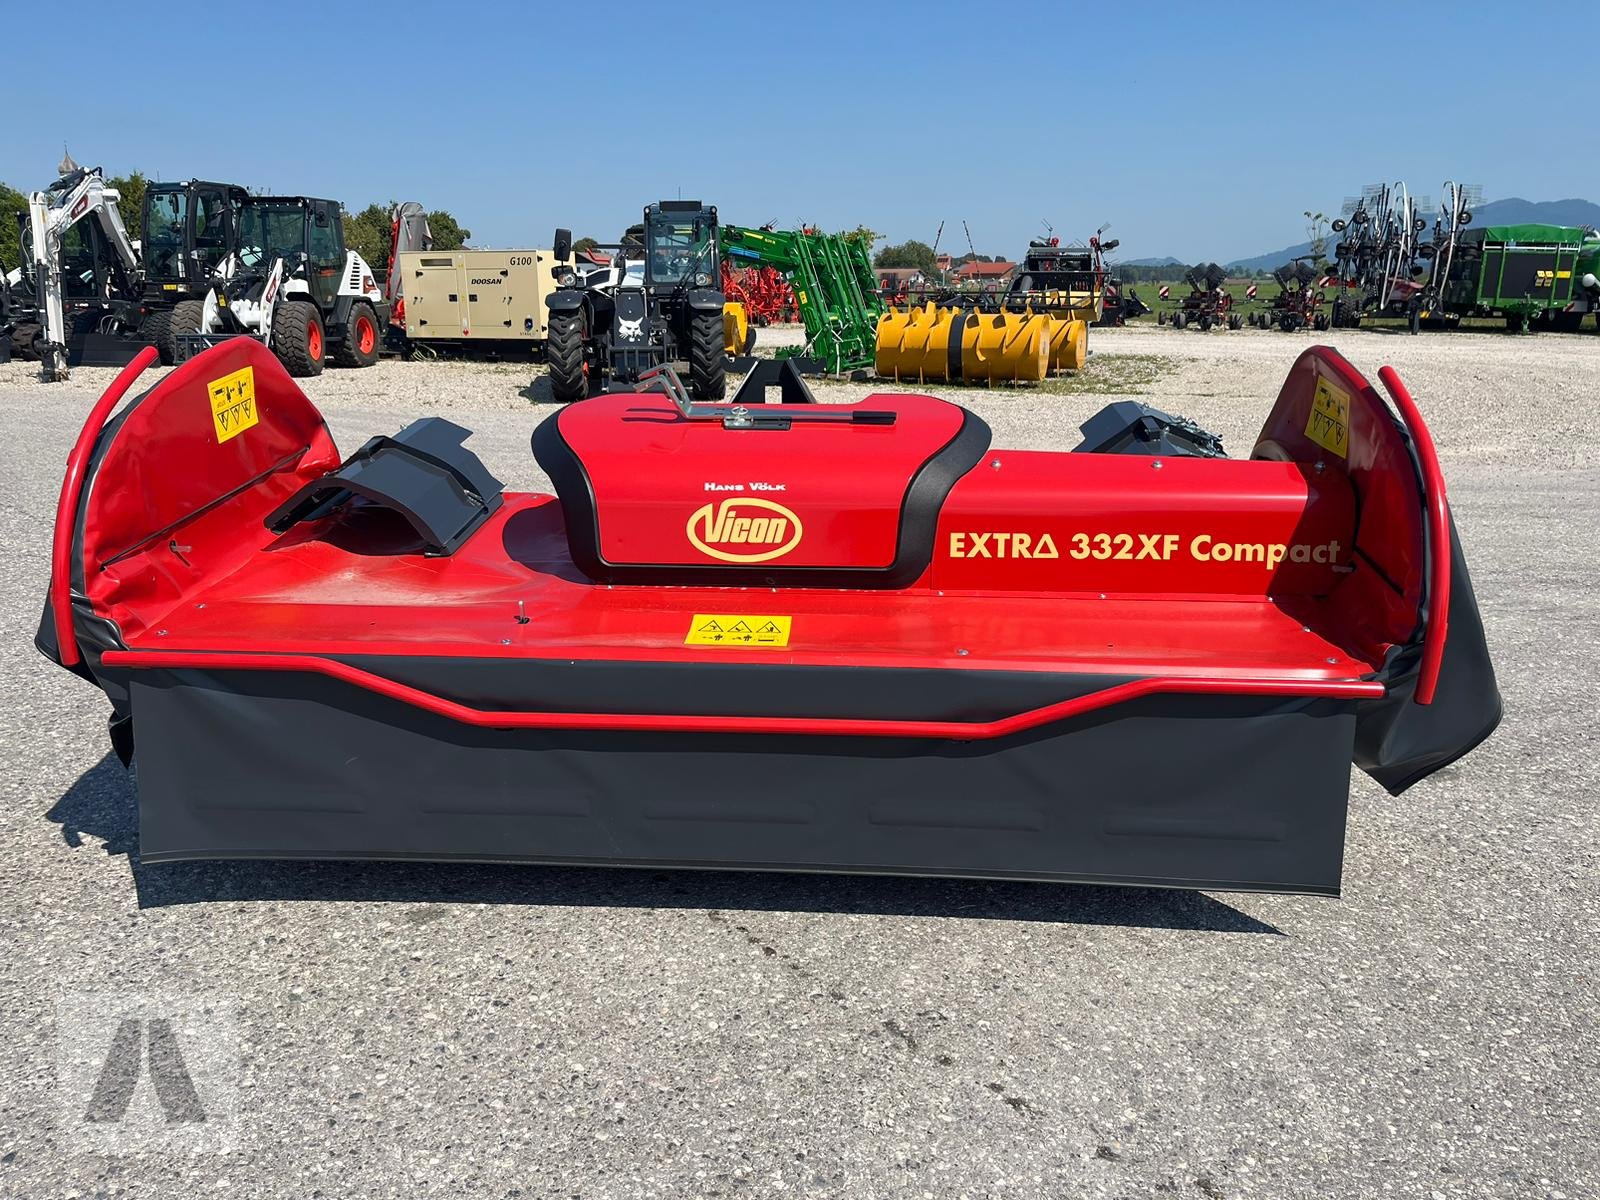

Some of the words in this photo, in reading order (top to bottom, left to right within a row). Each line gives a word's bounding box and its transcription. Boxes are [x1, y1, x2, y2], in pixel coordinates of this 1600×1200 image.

[509, 256, 532, 266] G100
[704, 482, 744, 491] HANS
[702, 498, 790, 545] Vicon
[949, 532, 1060, 560] EXTRA
[1069, 534, 1180, 561] 332XF
[1190, 534, 1341, 570] Compact
